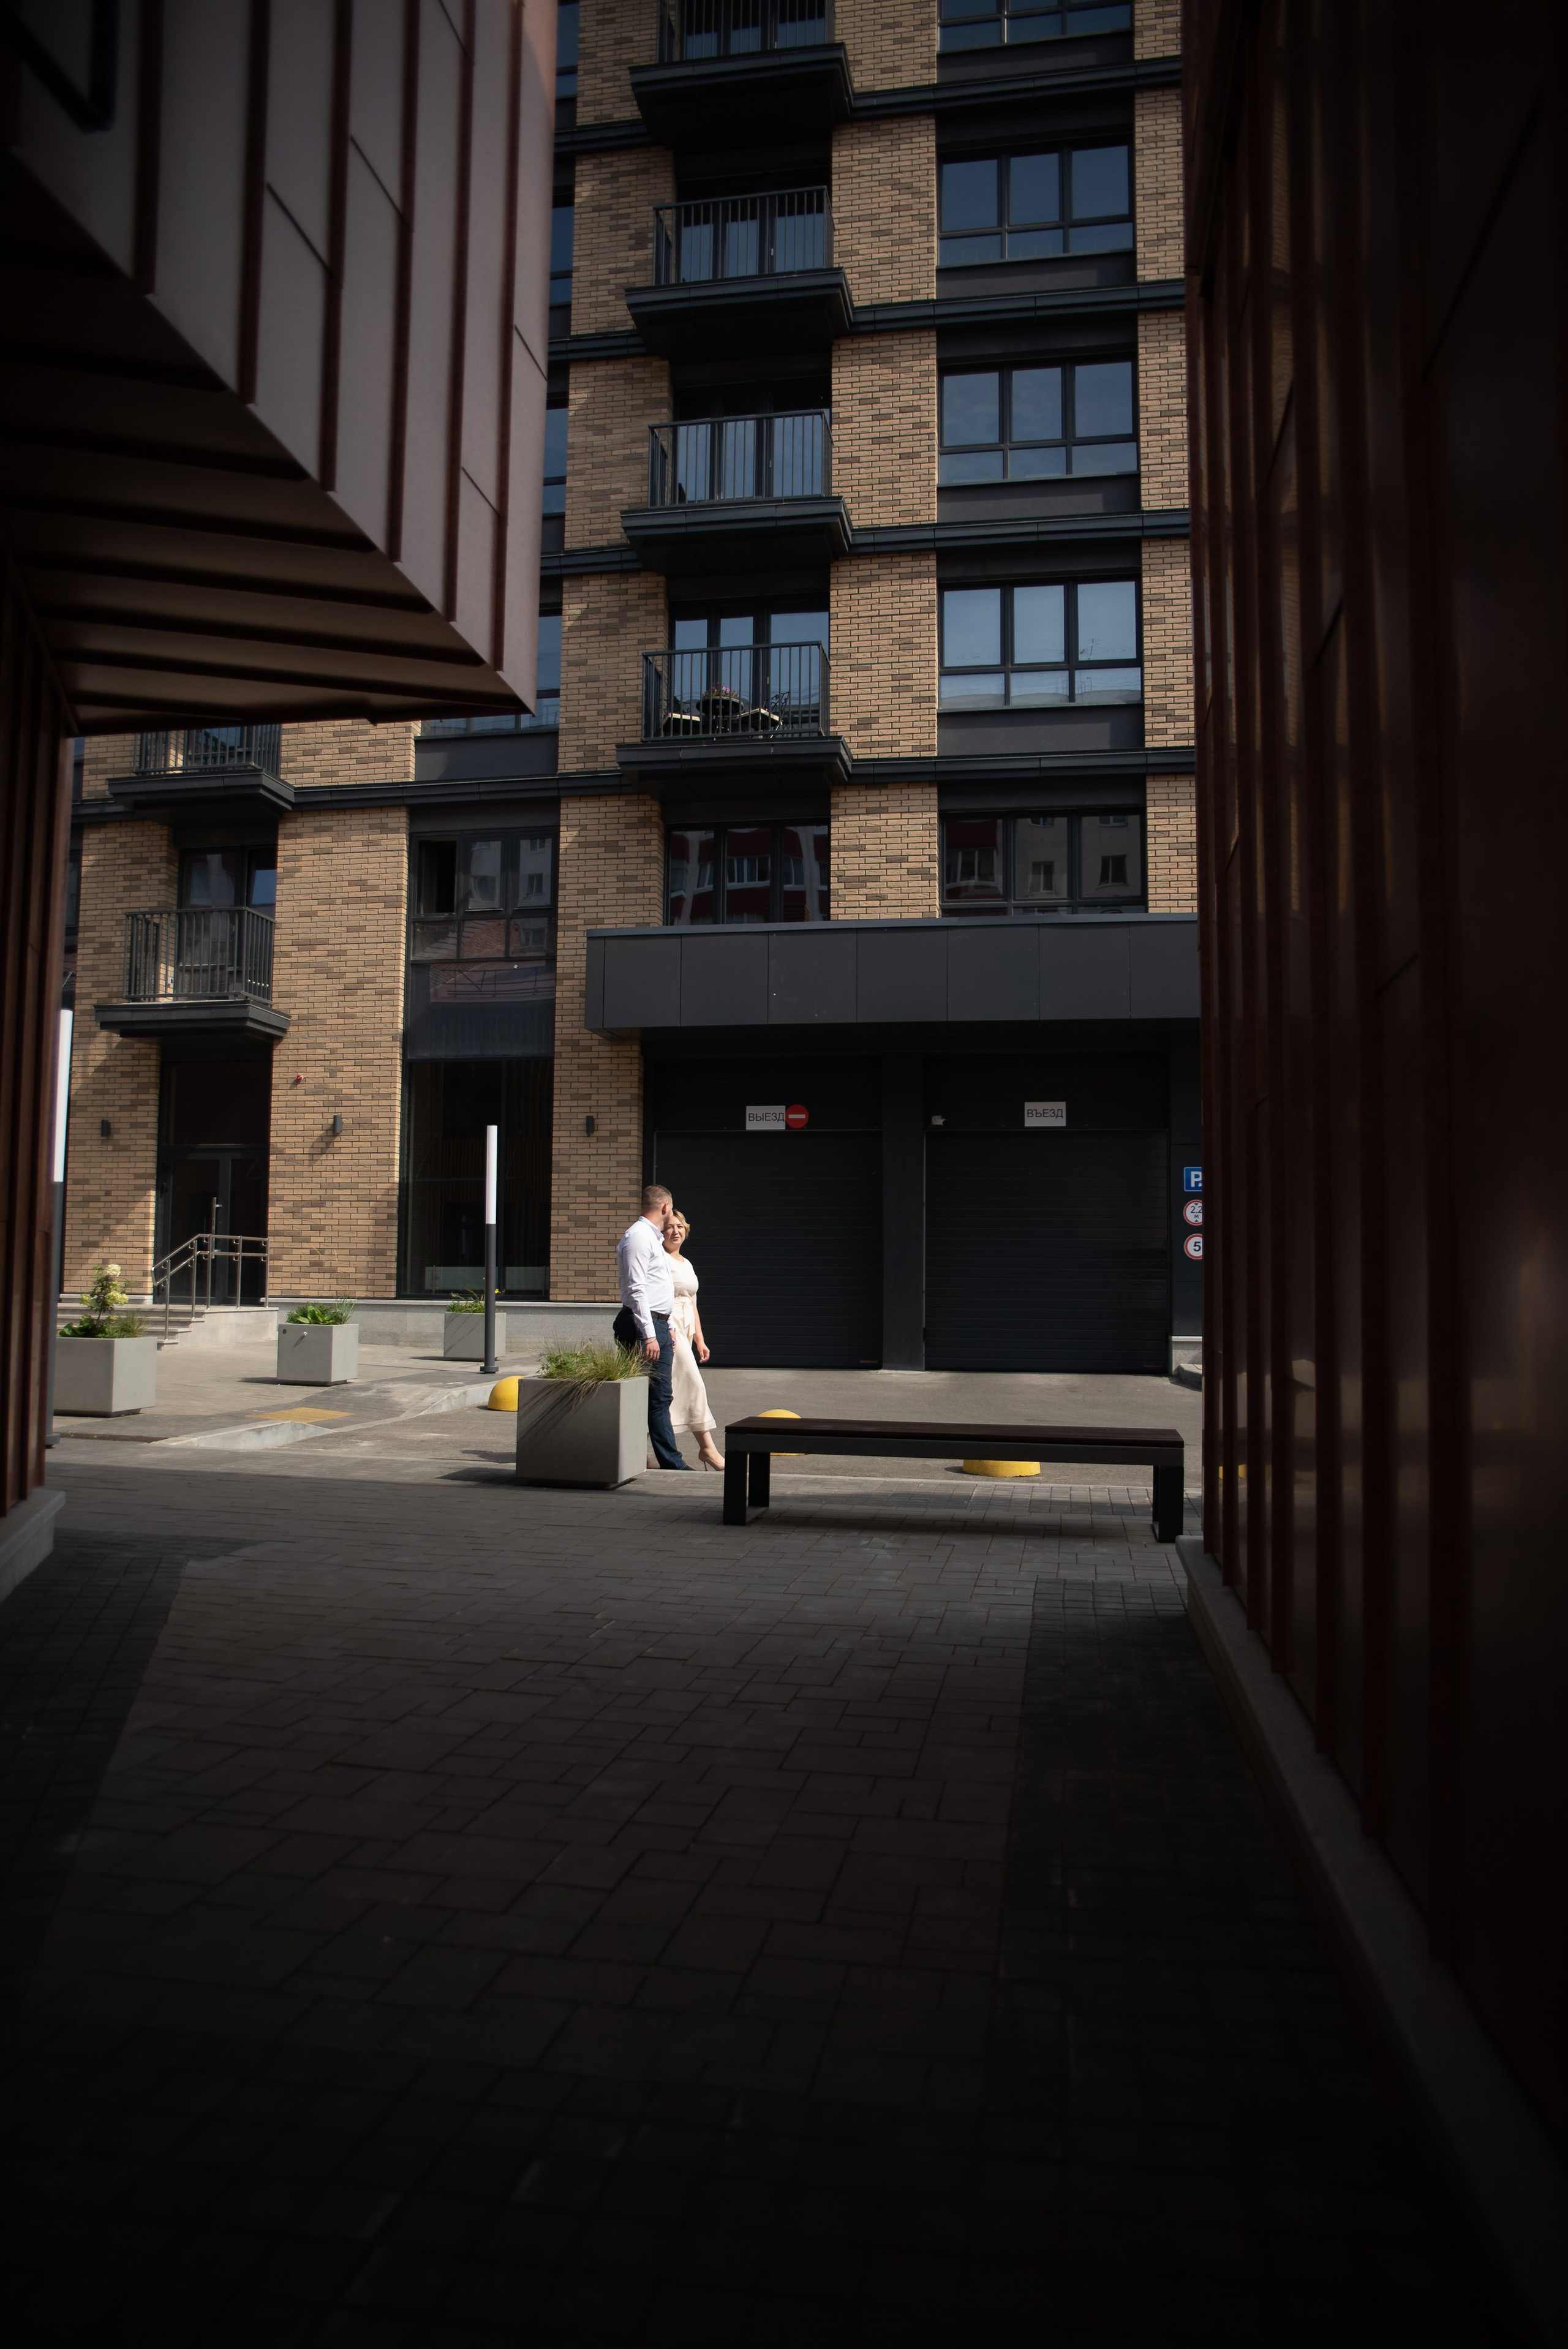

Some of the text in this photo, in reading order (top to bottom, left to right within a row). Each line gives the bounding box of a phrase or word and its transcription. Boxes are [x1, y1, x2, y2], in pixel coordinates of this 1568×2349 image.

[748, 1112, 785, 1123] ВЫЕЗД
[1027, 1108, 1064, 1119] ВЪЕЗД
[1190, 1171, 1202, 1187] P
[1193, 1241, 1202, 1252] 5
